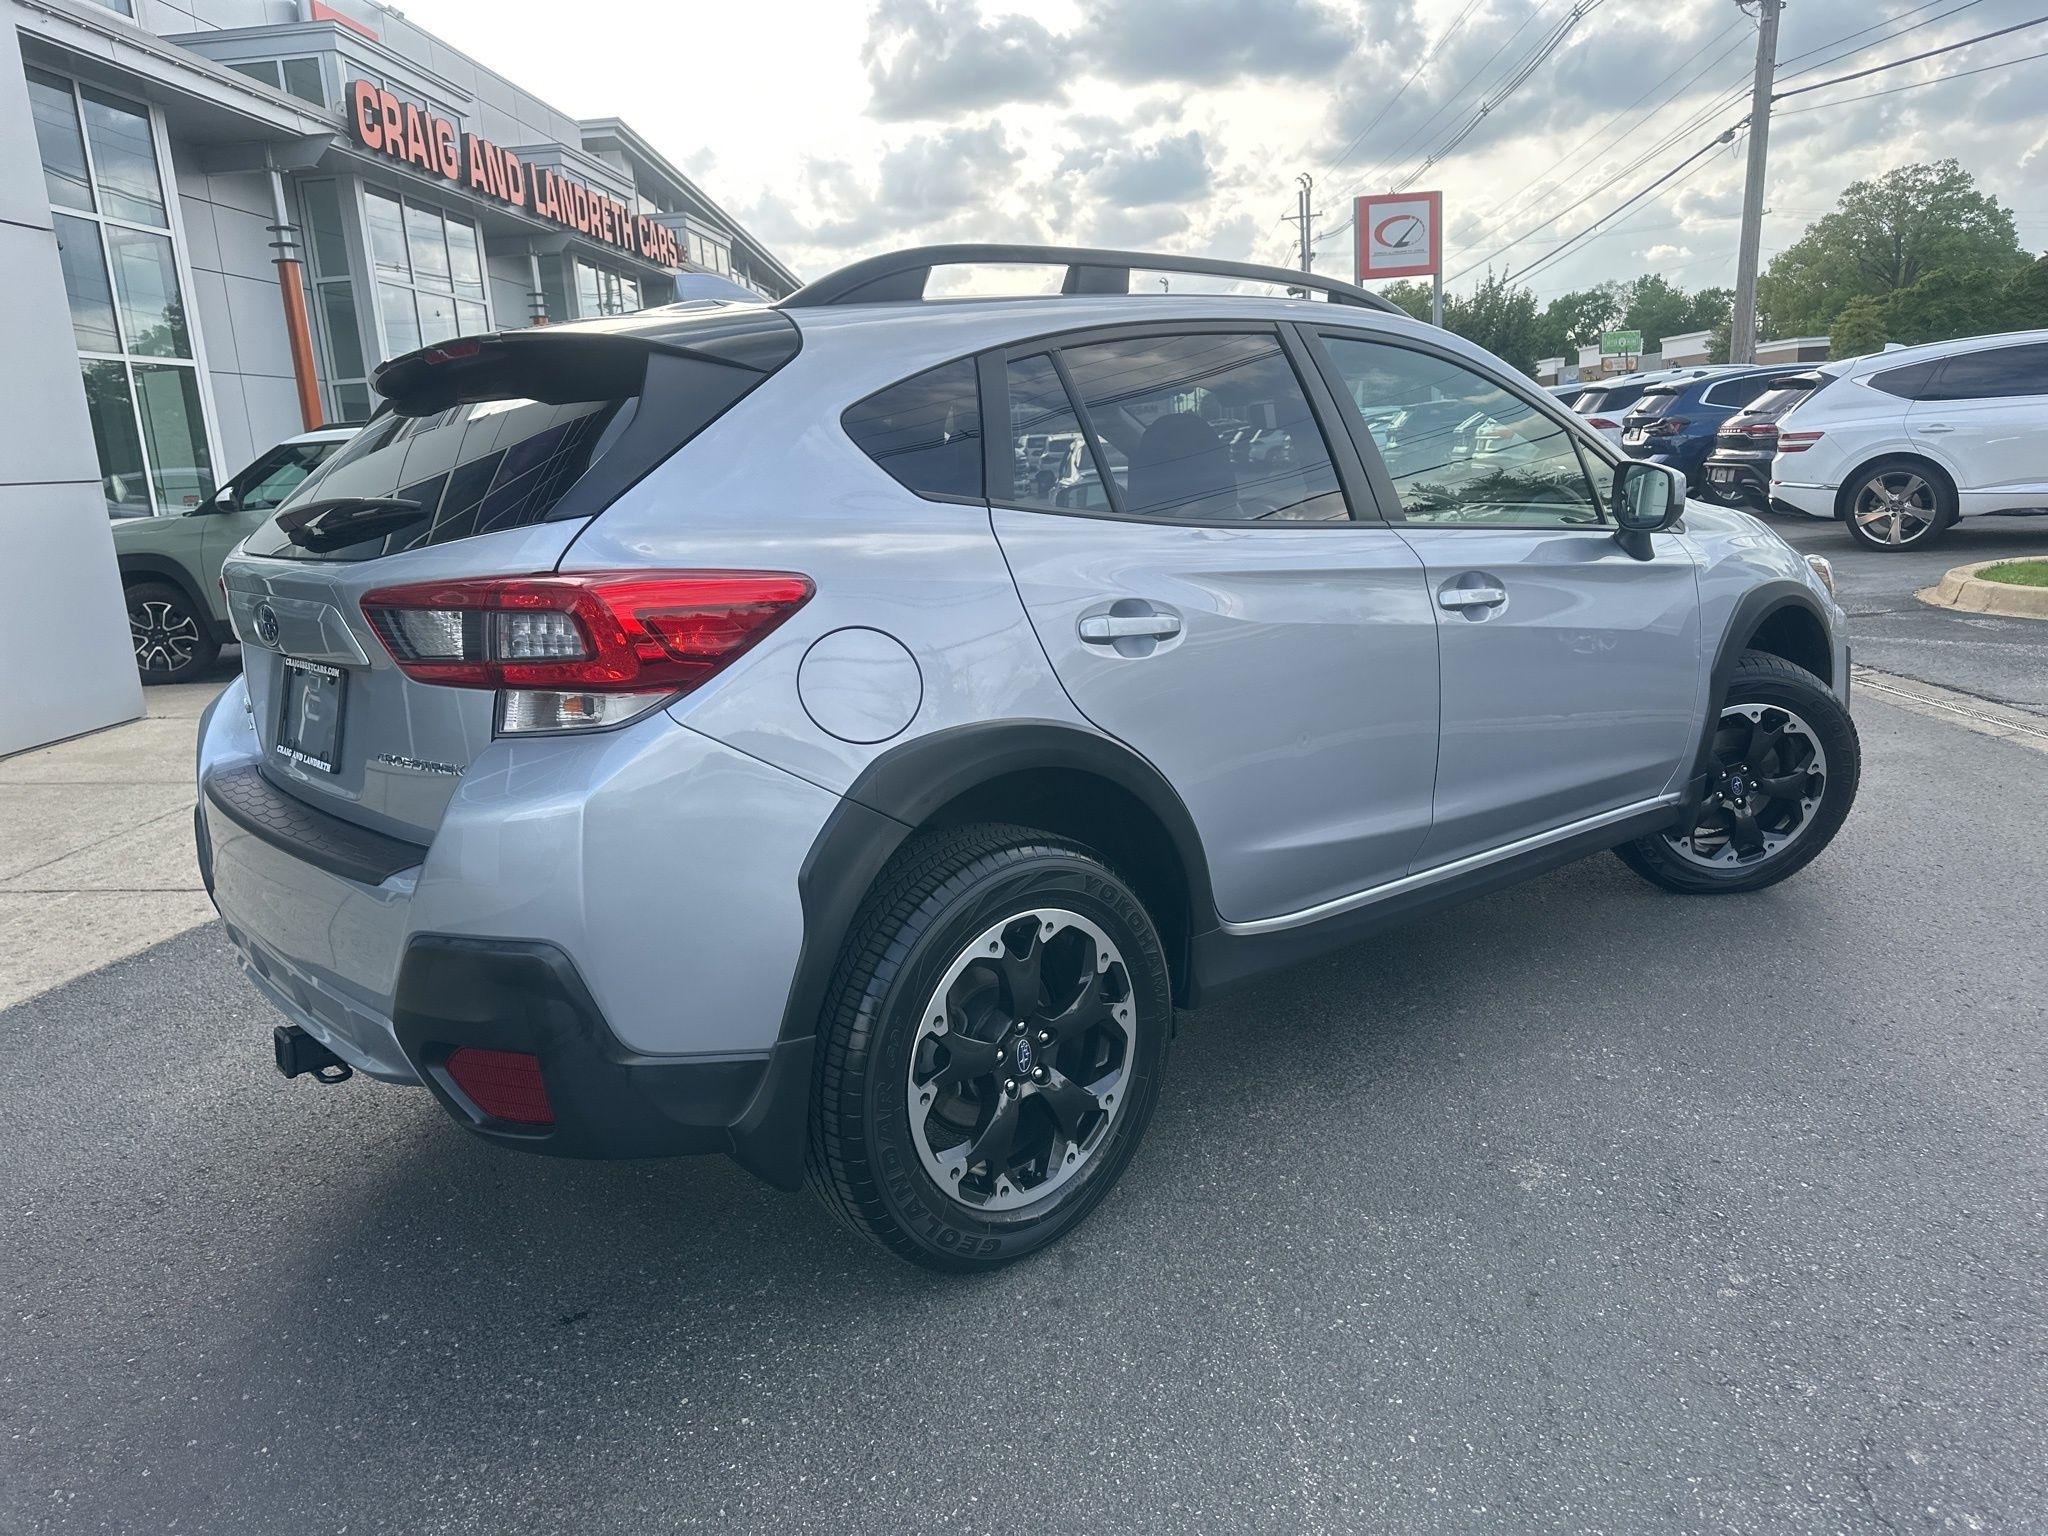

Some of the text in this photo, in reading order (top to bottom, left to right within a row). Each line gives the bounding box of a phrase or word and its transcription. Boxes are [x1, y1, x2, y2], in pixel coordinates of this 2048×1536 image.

[353, 79, 678, 268] CRAIG AND LANDRETH CARS
[276, 744, 332, 774] CRAIG AND LANDRETH
[1084, 872, 1170, 1023] YOKOHAMA
[876, 1081, 1004, 1257] GEOLANDAR
